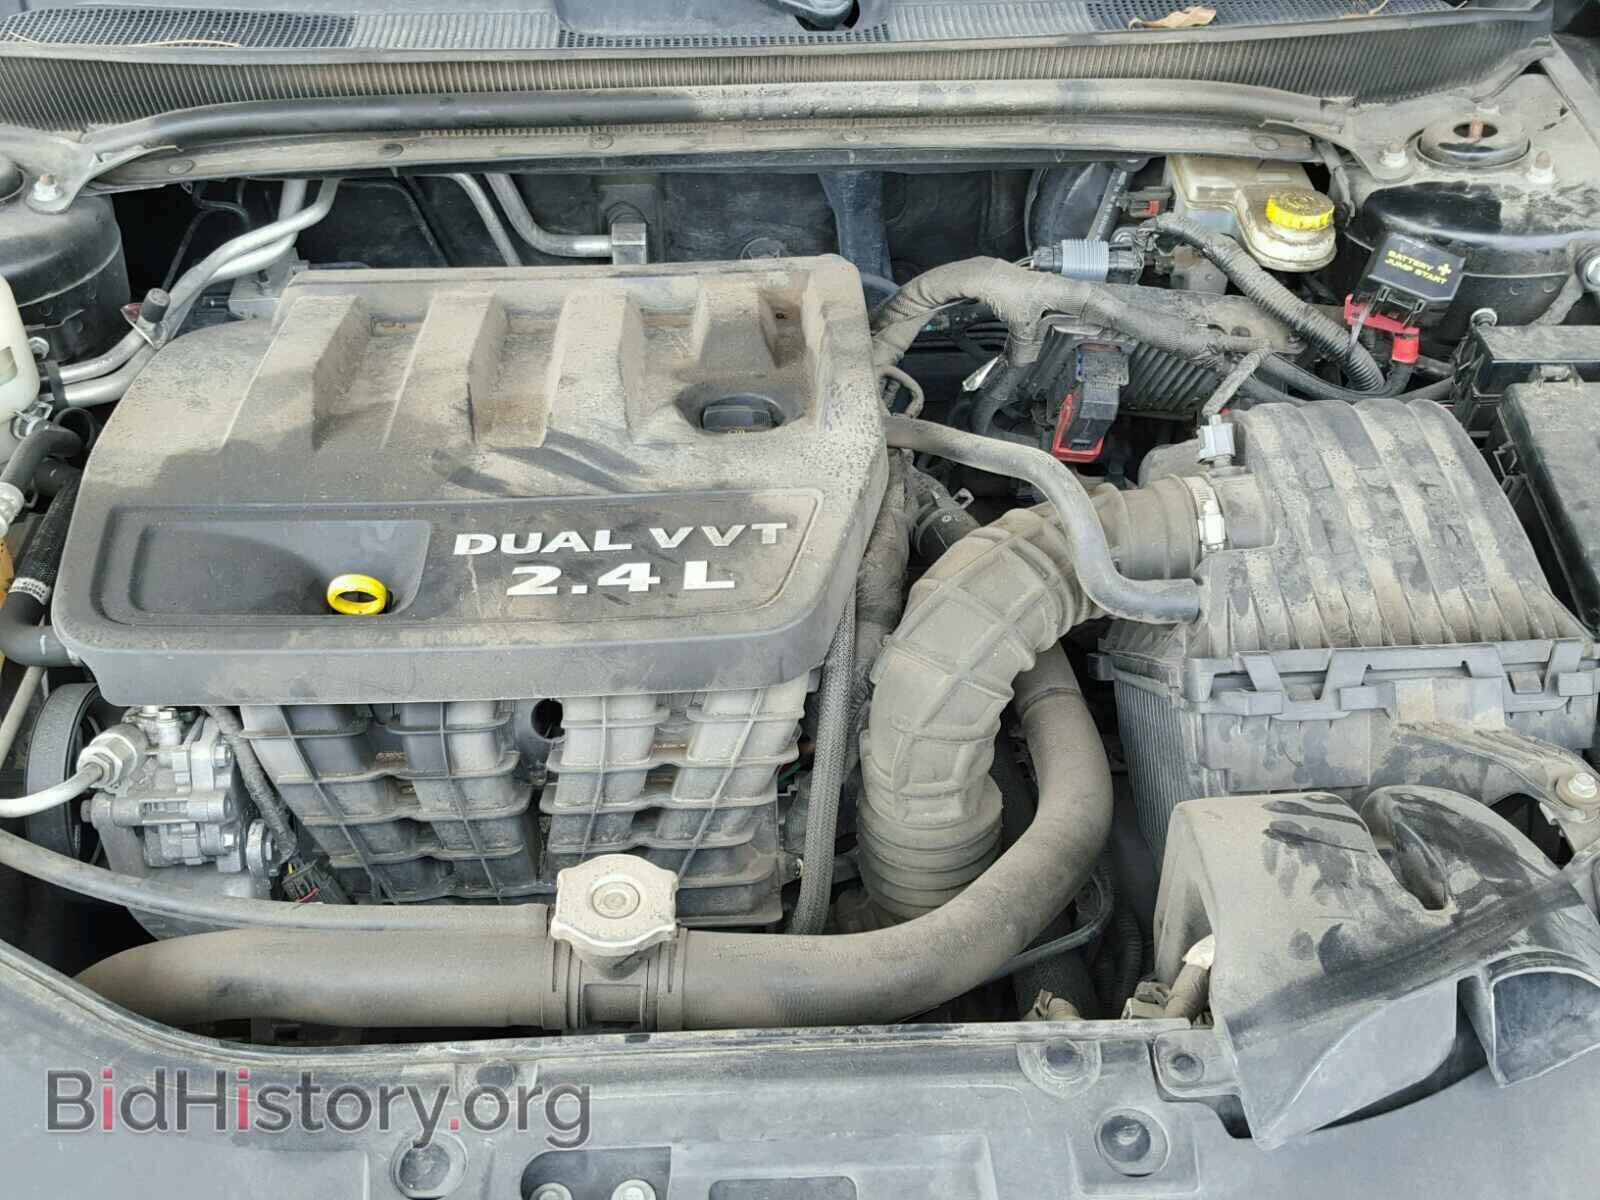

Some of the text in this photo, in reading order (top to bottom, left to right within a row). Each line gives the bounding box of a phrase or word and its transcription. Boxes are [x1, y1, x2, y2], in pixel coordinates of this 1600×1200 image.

[1384, 258, 1448, 284] JUMP START
[1387, 250, 1435, 270] BATTERY
[453, 522, 788, 556] DUAL VVT
